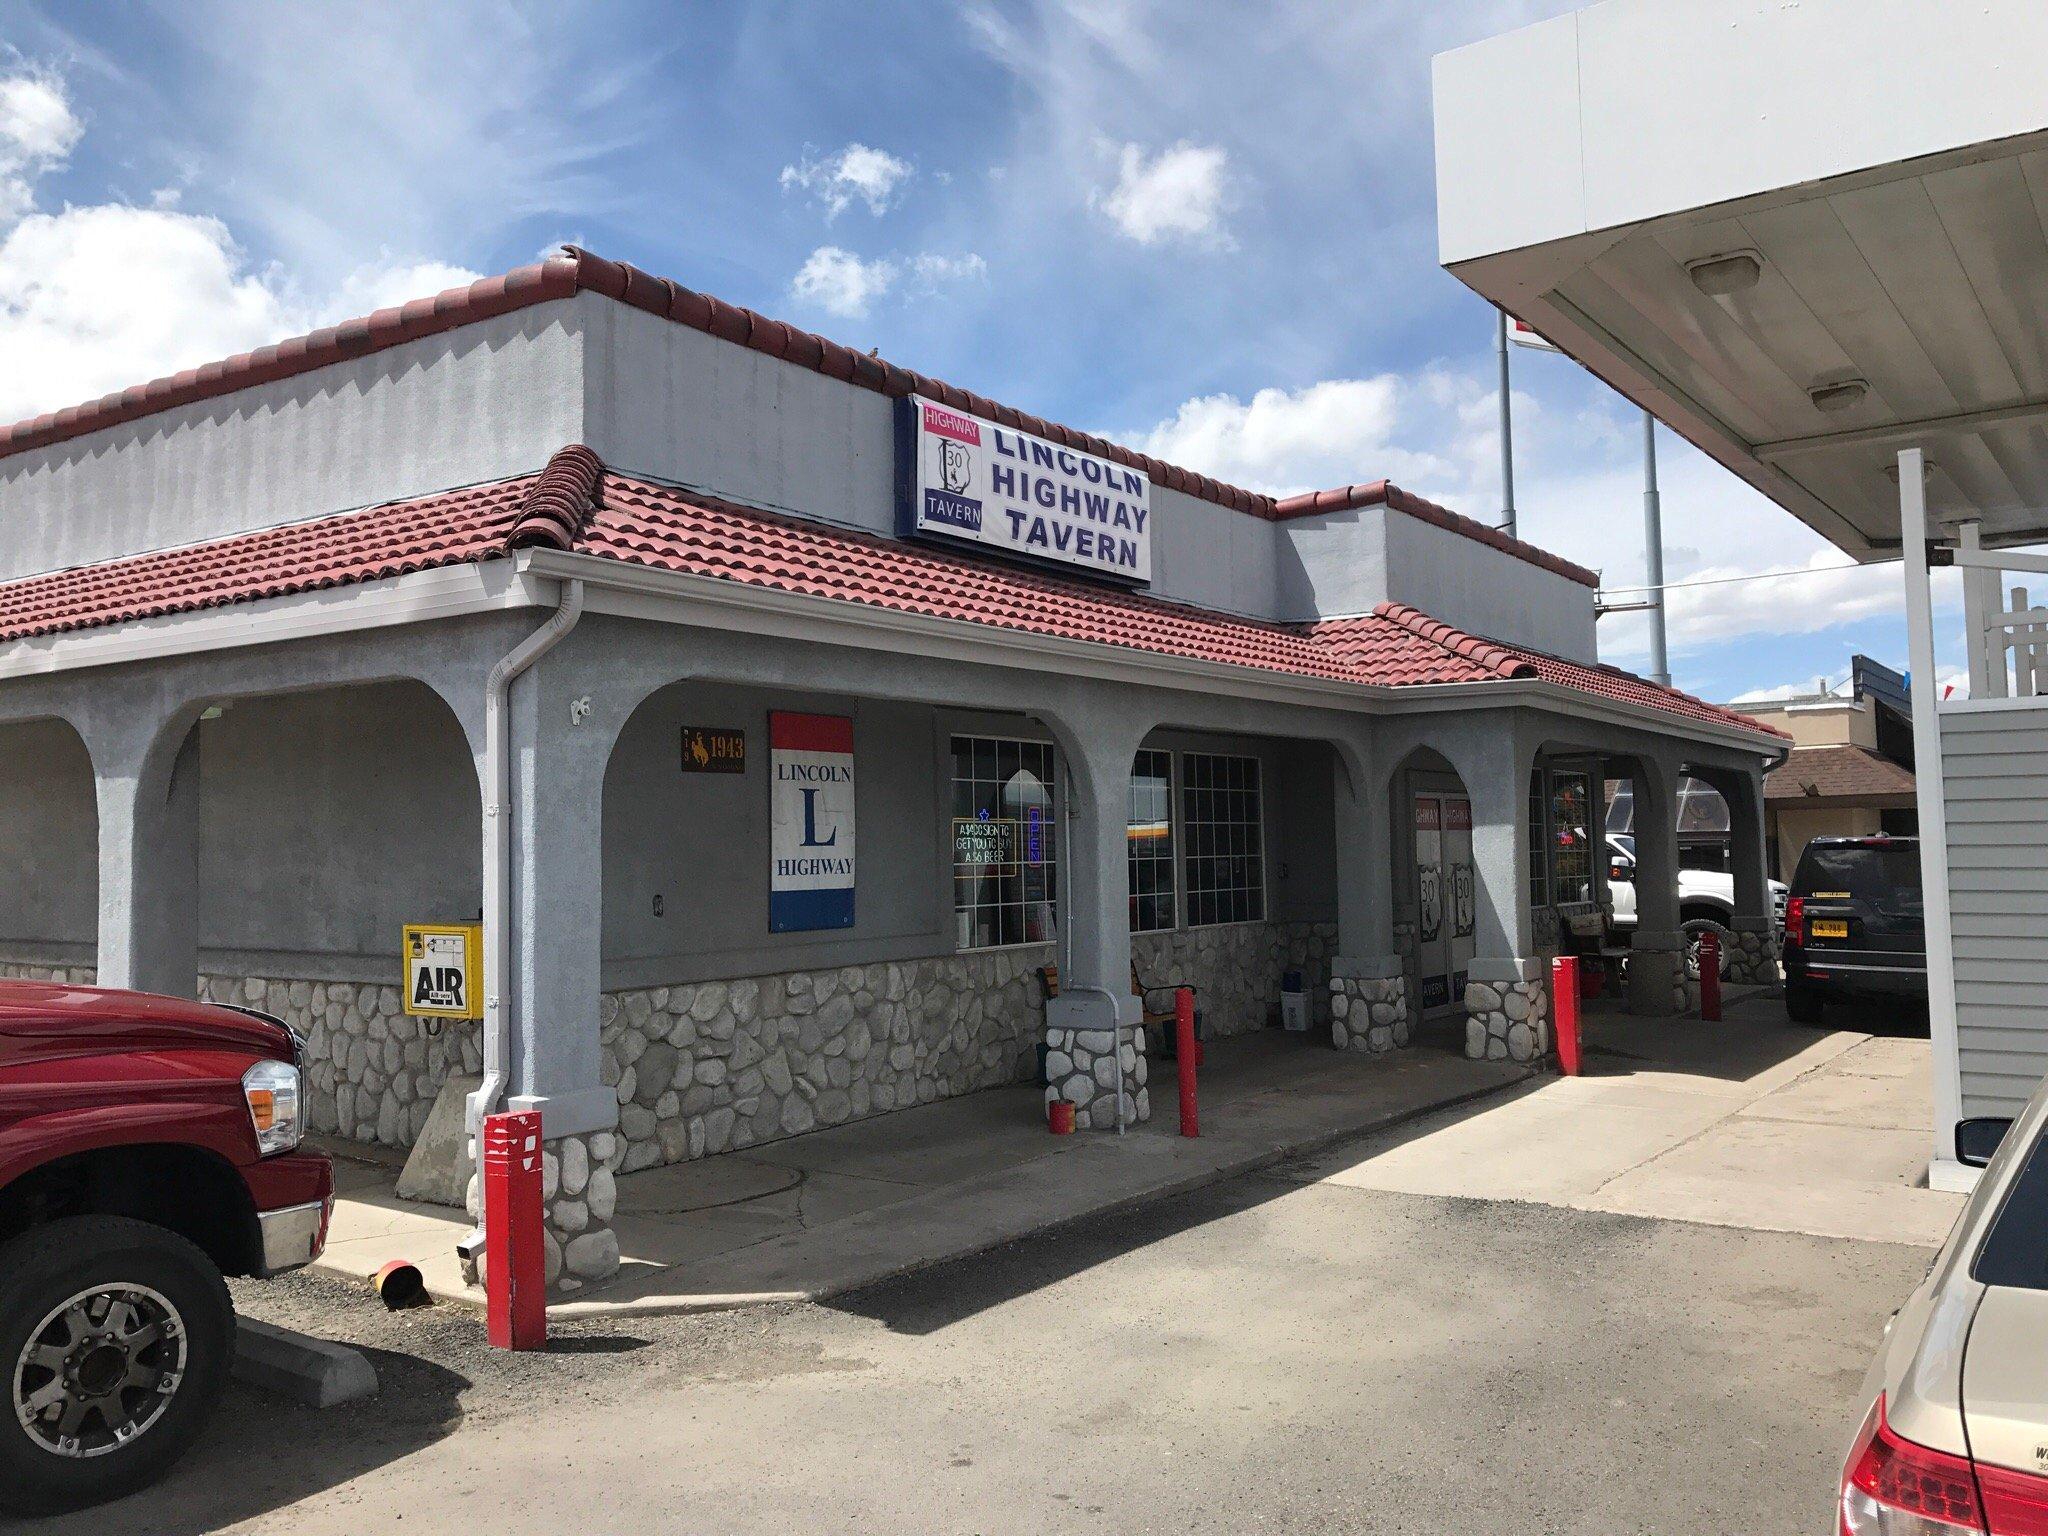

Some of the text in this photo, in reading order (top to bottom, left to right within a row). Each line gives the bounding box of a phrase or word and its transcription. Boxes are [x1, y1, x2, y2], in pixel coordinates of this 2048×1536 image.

[925, 409, 978, 438] HIGHWAY
[947, 449, 962, 469] 30
[993, 428, 1142, 497] LINCOLN
[927, 497, 981, 524] TAVERN
[992, 463, 1148, 534] HIGHWAY
[1005, 508, 1137, 569] TAVERN
[711, 736, 743, 759] 1943
[778, 764, 851, 783] LINCOLN
[799, 788, 836, 846] L
[777, 858, 853, 876] HIGHWAY
[984, 850, 1004, 862] BEER
[1422, 880, 1435, 902] 30
[1457, 877, 1469, 899] 30
[414, 967, 463, 1006] AIR
